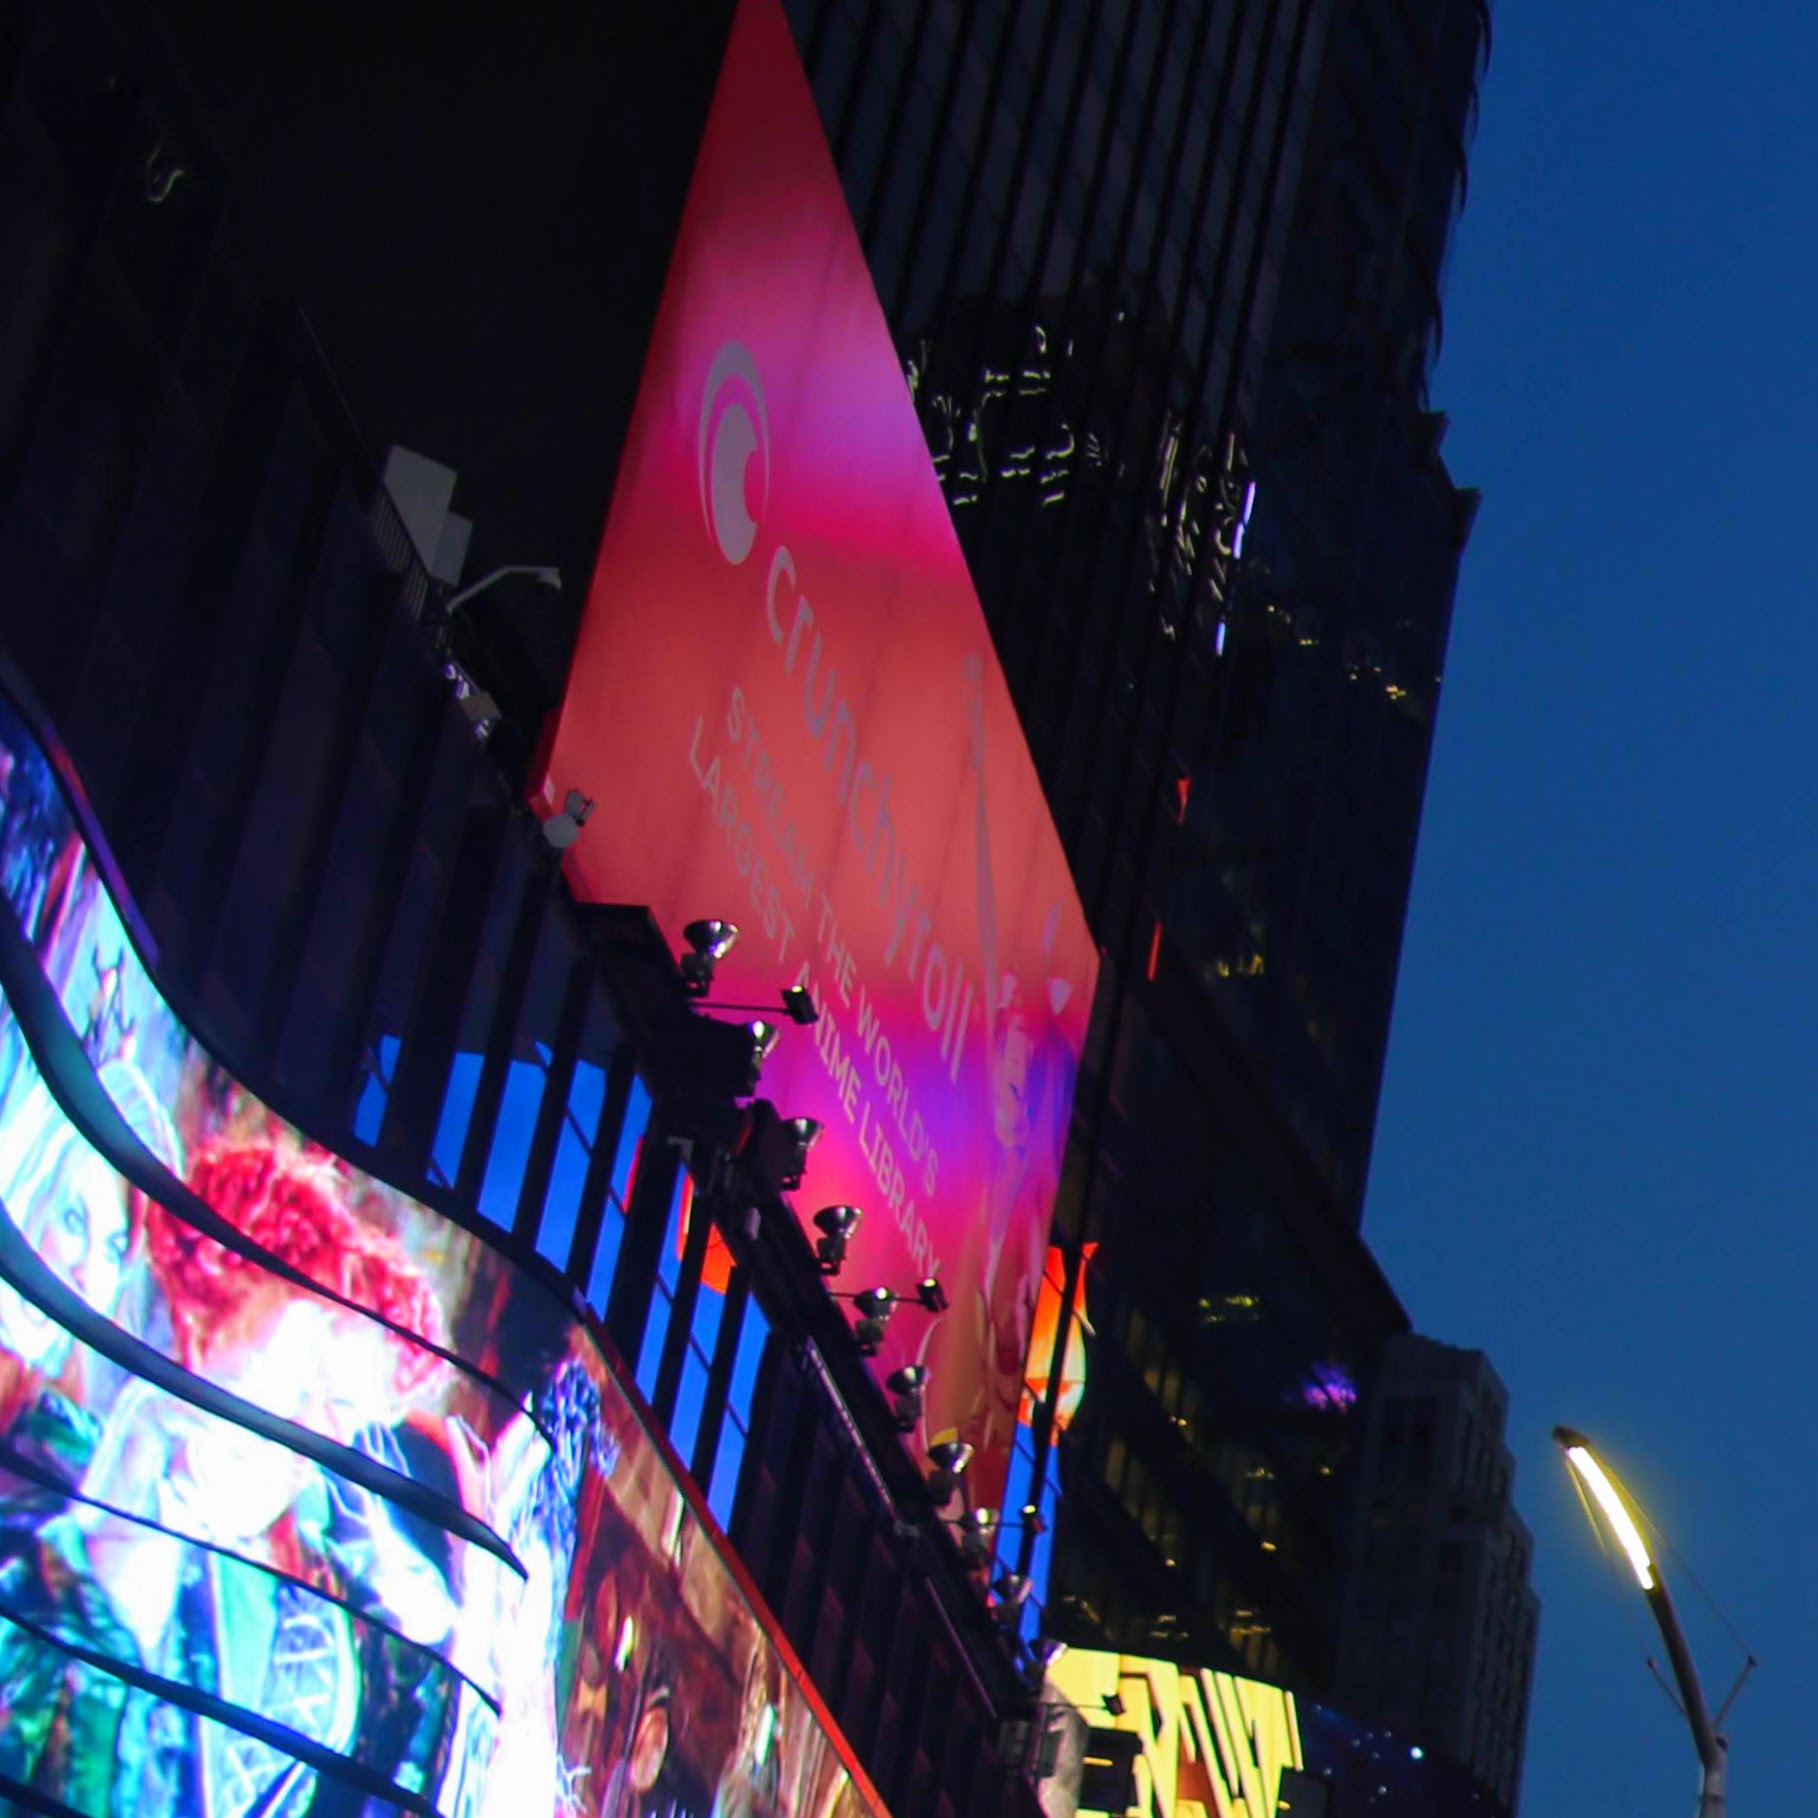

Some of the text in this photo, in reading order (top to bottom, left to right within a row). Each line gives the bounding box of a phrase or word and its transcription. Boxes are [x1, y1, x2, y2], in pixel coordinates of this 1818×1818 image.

[689, 712, 796, 964] LARGEST
[859, 1117, 942, 1280] LIBRARY
[727, 685, 941, 1199] STREAM THE WORLD'S
